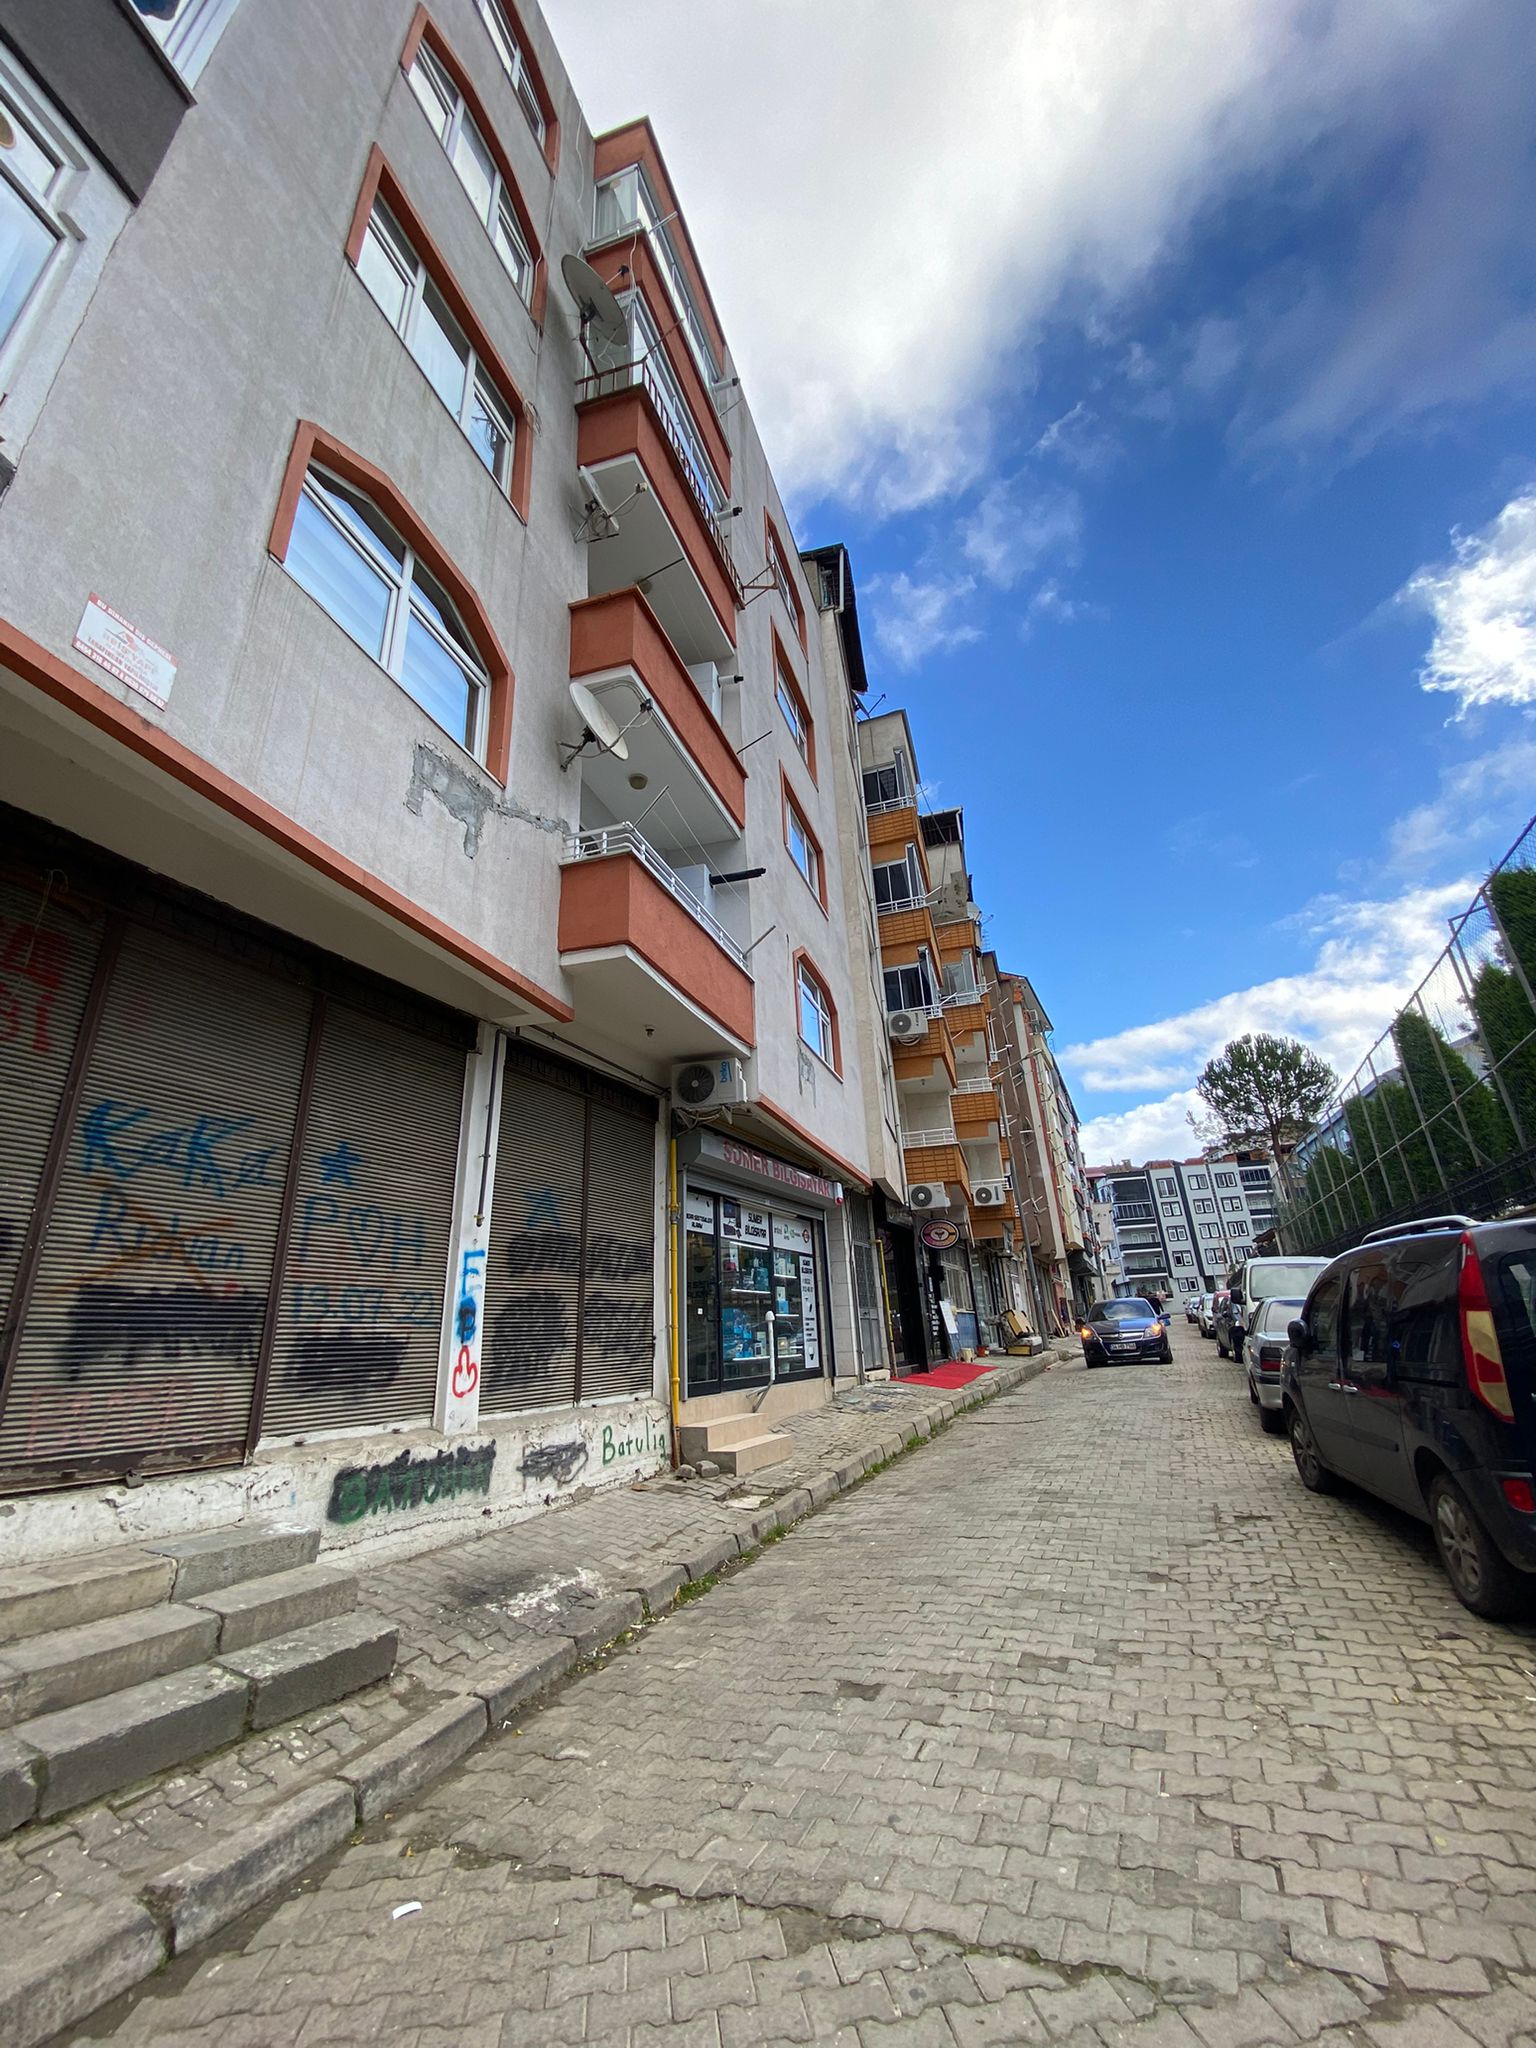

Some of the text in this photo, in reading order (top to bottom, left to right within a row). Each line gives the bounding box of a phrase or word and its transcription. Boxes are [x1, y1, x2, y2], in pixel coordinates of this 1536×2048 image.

[97, 599, 106, 610] BU
[723, 1137, 830, 1196] SÜMER BİLGİSAYAR
